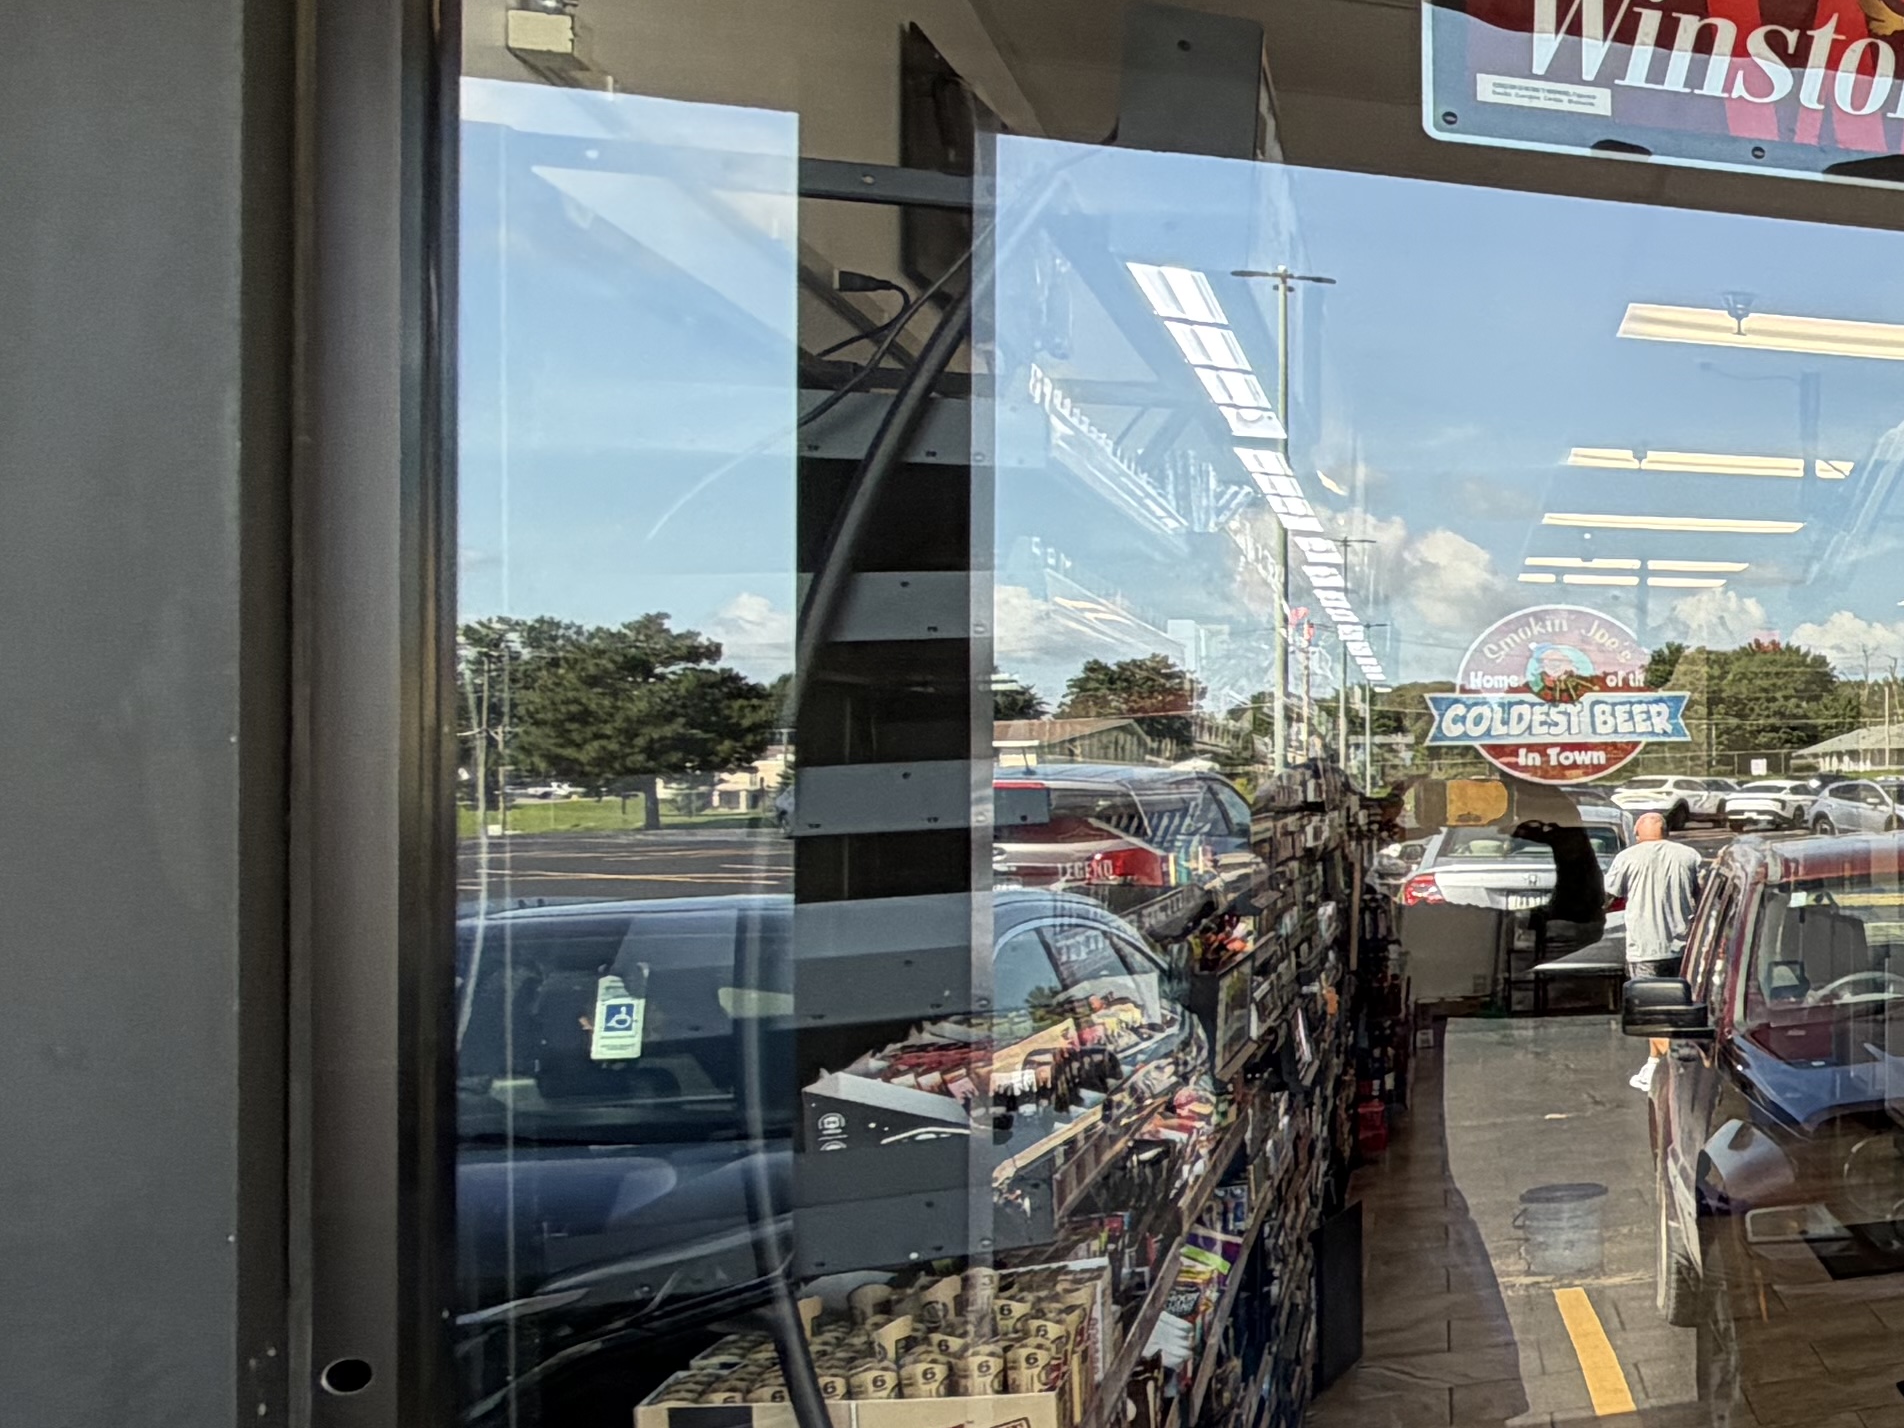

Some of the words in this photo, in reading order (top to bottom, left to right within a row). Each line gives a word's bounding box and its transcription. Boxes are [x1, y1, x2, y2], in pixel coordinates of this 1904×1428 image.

[1469, 670, 1518, 689] Home
[1606, 670, 1626, 687] of
[1629, 670, 1645, 687] th
[1441, 701, 1584, 738] COLDEST
[1593, 700, 1673, 736] BEER
[1518, 747, 1541, 767] In
[1546, 747, 1607, 766] Town
[999, 1303, 1013, 1318] 6
[977, 1358, 992, 1375] 6
[1024, 1351, 1040, 1367] 6
[872, 1373, 887, 1390] 6
[923, 1364, 937, 1382] 6
[823, 1380, 837, 1397] 6
